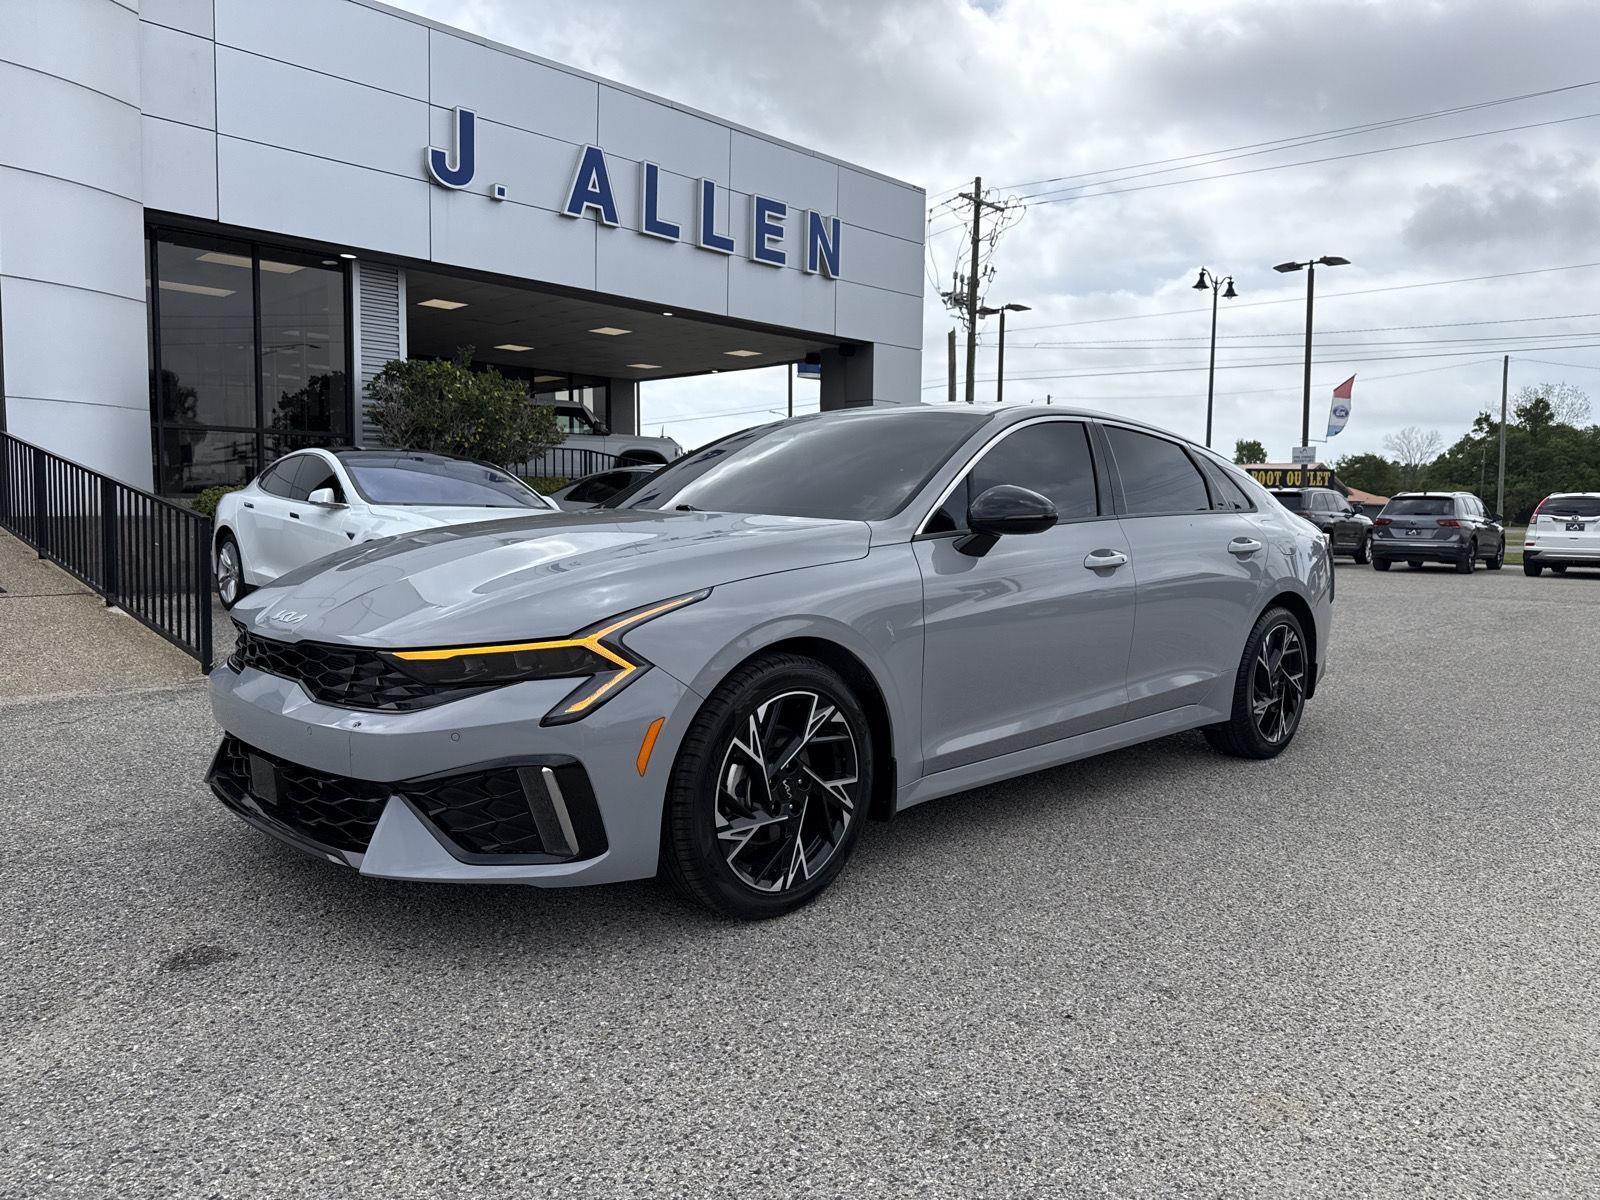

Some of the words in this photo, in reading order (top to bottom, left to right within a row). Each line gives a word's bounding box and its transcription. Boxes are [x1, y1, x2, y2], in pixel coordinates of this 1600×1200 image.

[424, 106, 508, 201] J.
[560, 144, 842, 280] ALLEN
[1286, 471, 1331, 486] OULET
